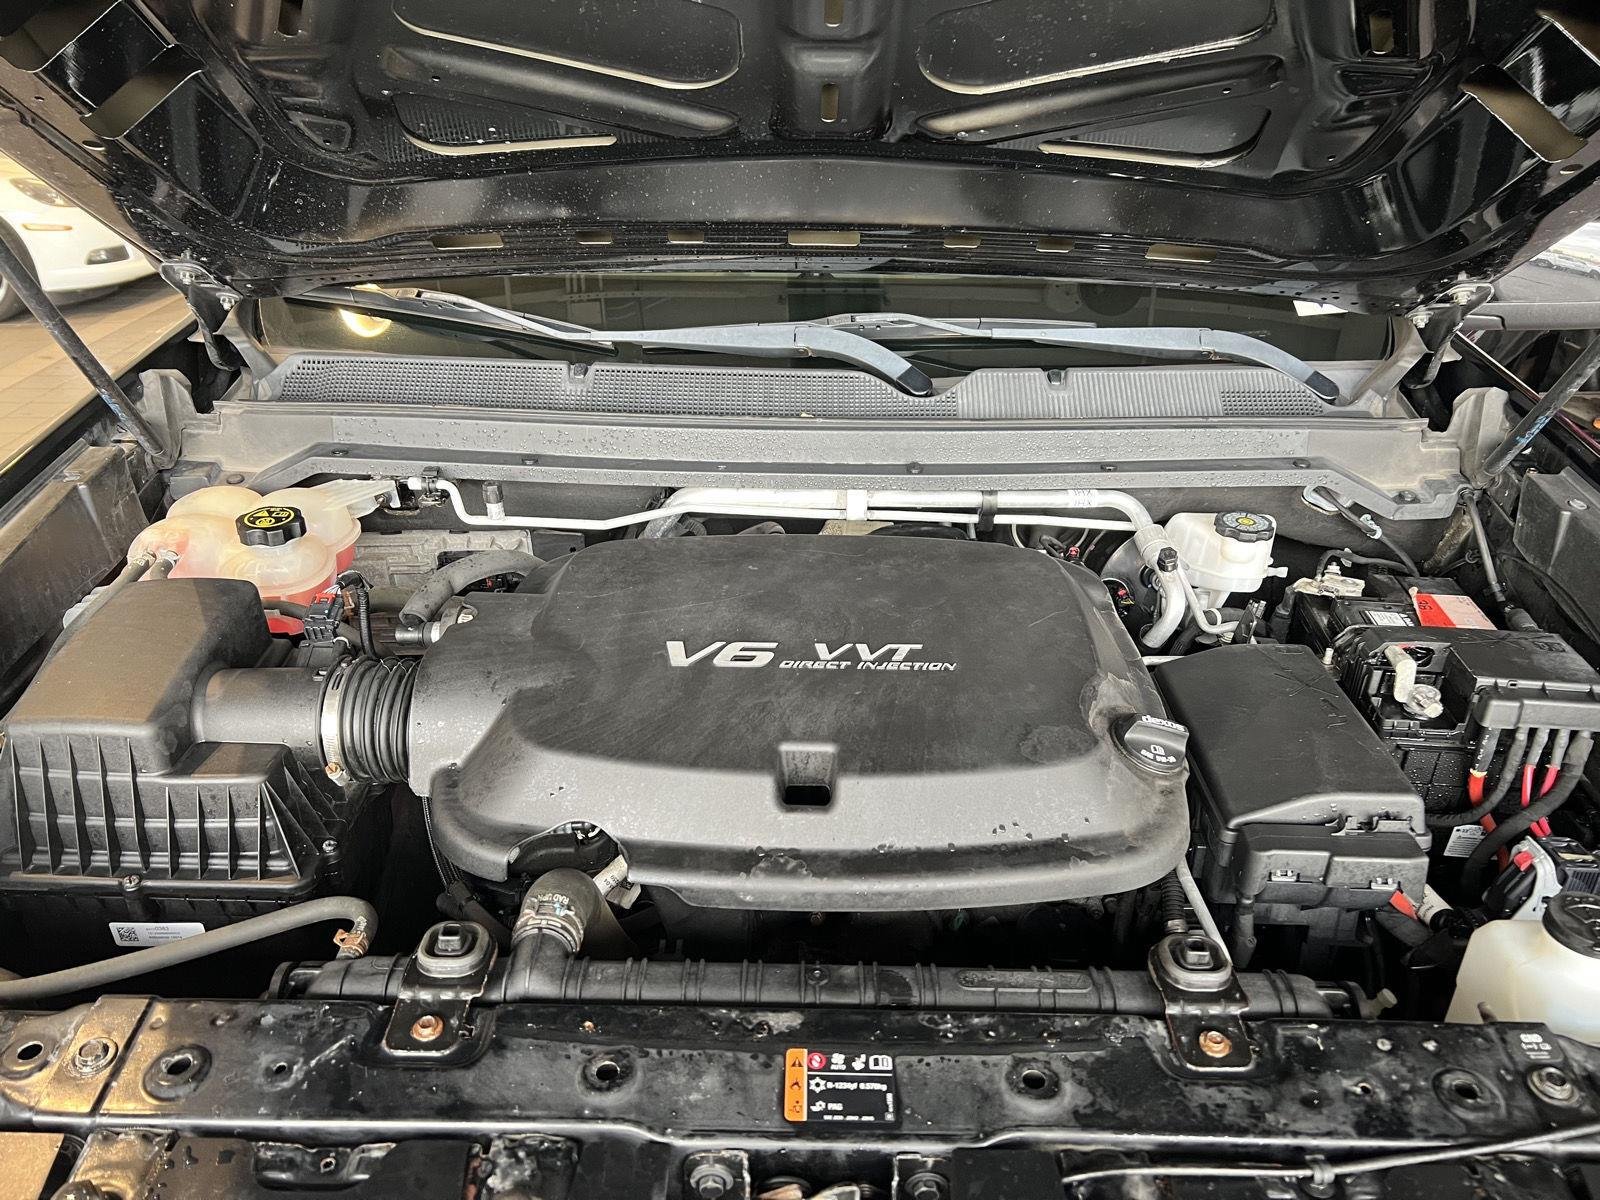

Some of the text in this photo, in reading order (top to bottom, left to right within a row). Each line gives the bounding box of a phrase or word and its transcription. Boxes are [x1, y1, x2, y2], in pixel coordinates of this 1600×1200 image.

[665, 640, 779, 668] V6
[814, 642, 924, 661] VVT
[778, 659, 958, 671] DIRECT INJECTION
[1141, 714, 1186, 732] dexos
